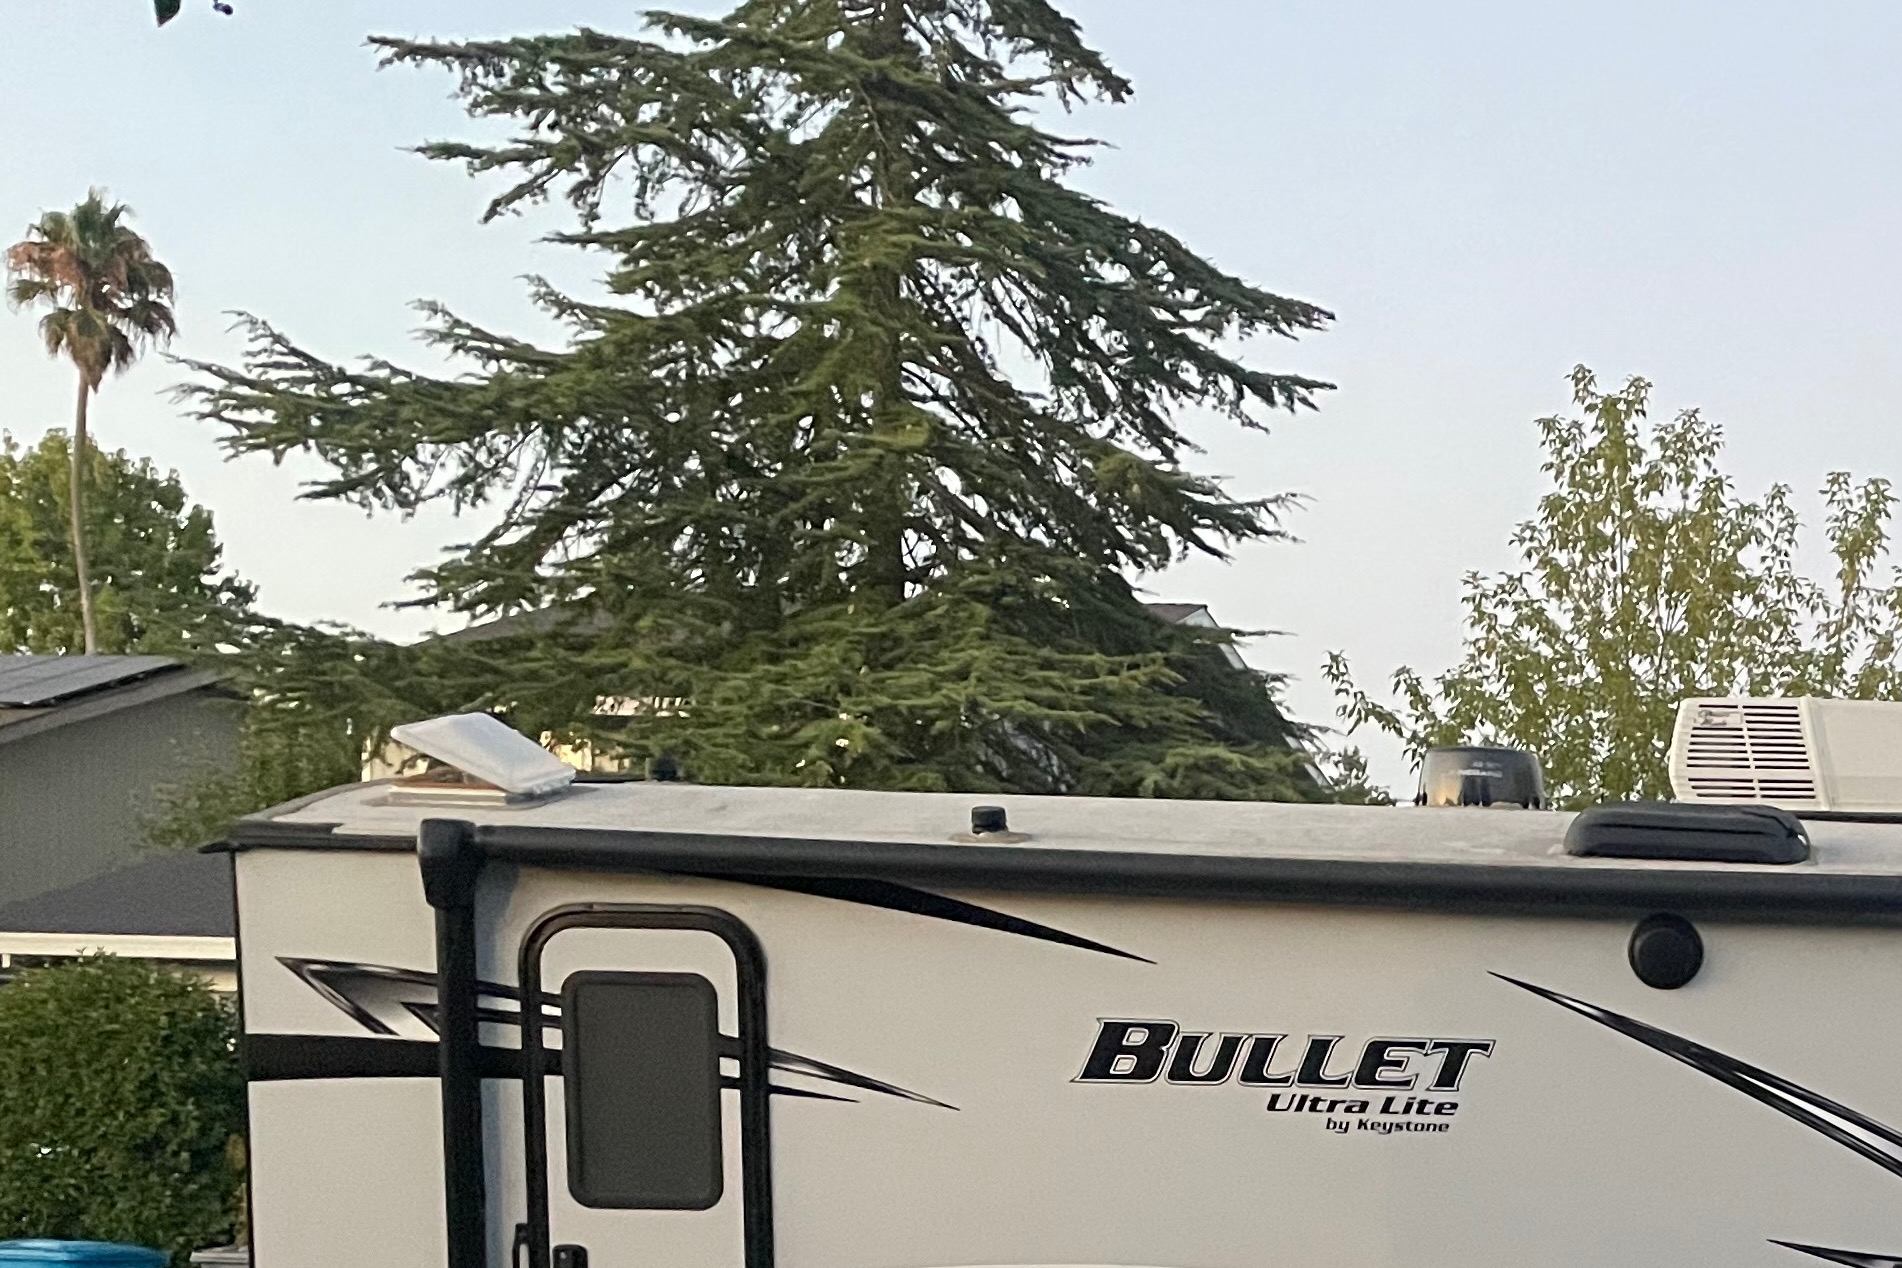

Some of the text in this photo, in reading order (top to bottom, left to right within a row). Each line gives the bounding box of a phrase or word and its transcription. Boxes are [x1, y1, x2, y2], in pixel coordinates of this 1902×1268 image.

[1070, 1018, 1496, 1091] BULLET
[1267, 1093, 1459, 1116] Ultra Lite
[1326, 1117, 1450, 1135] by Keystone
